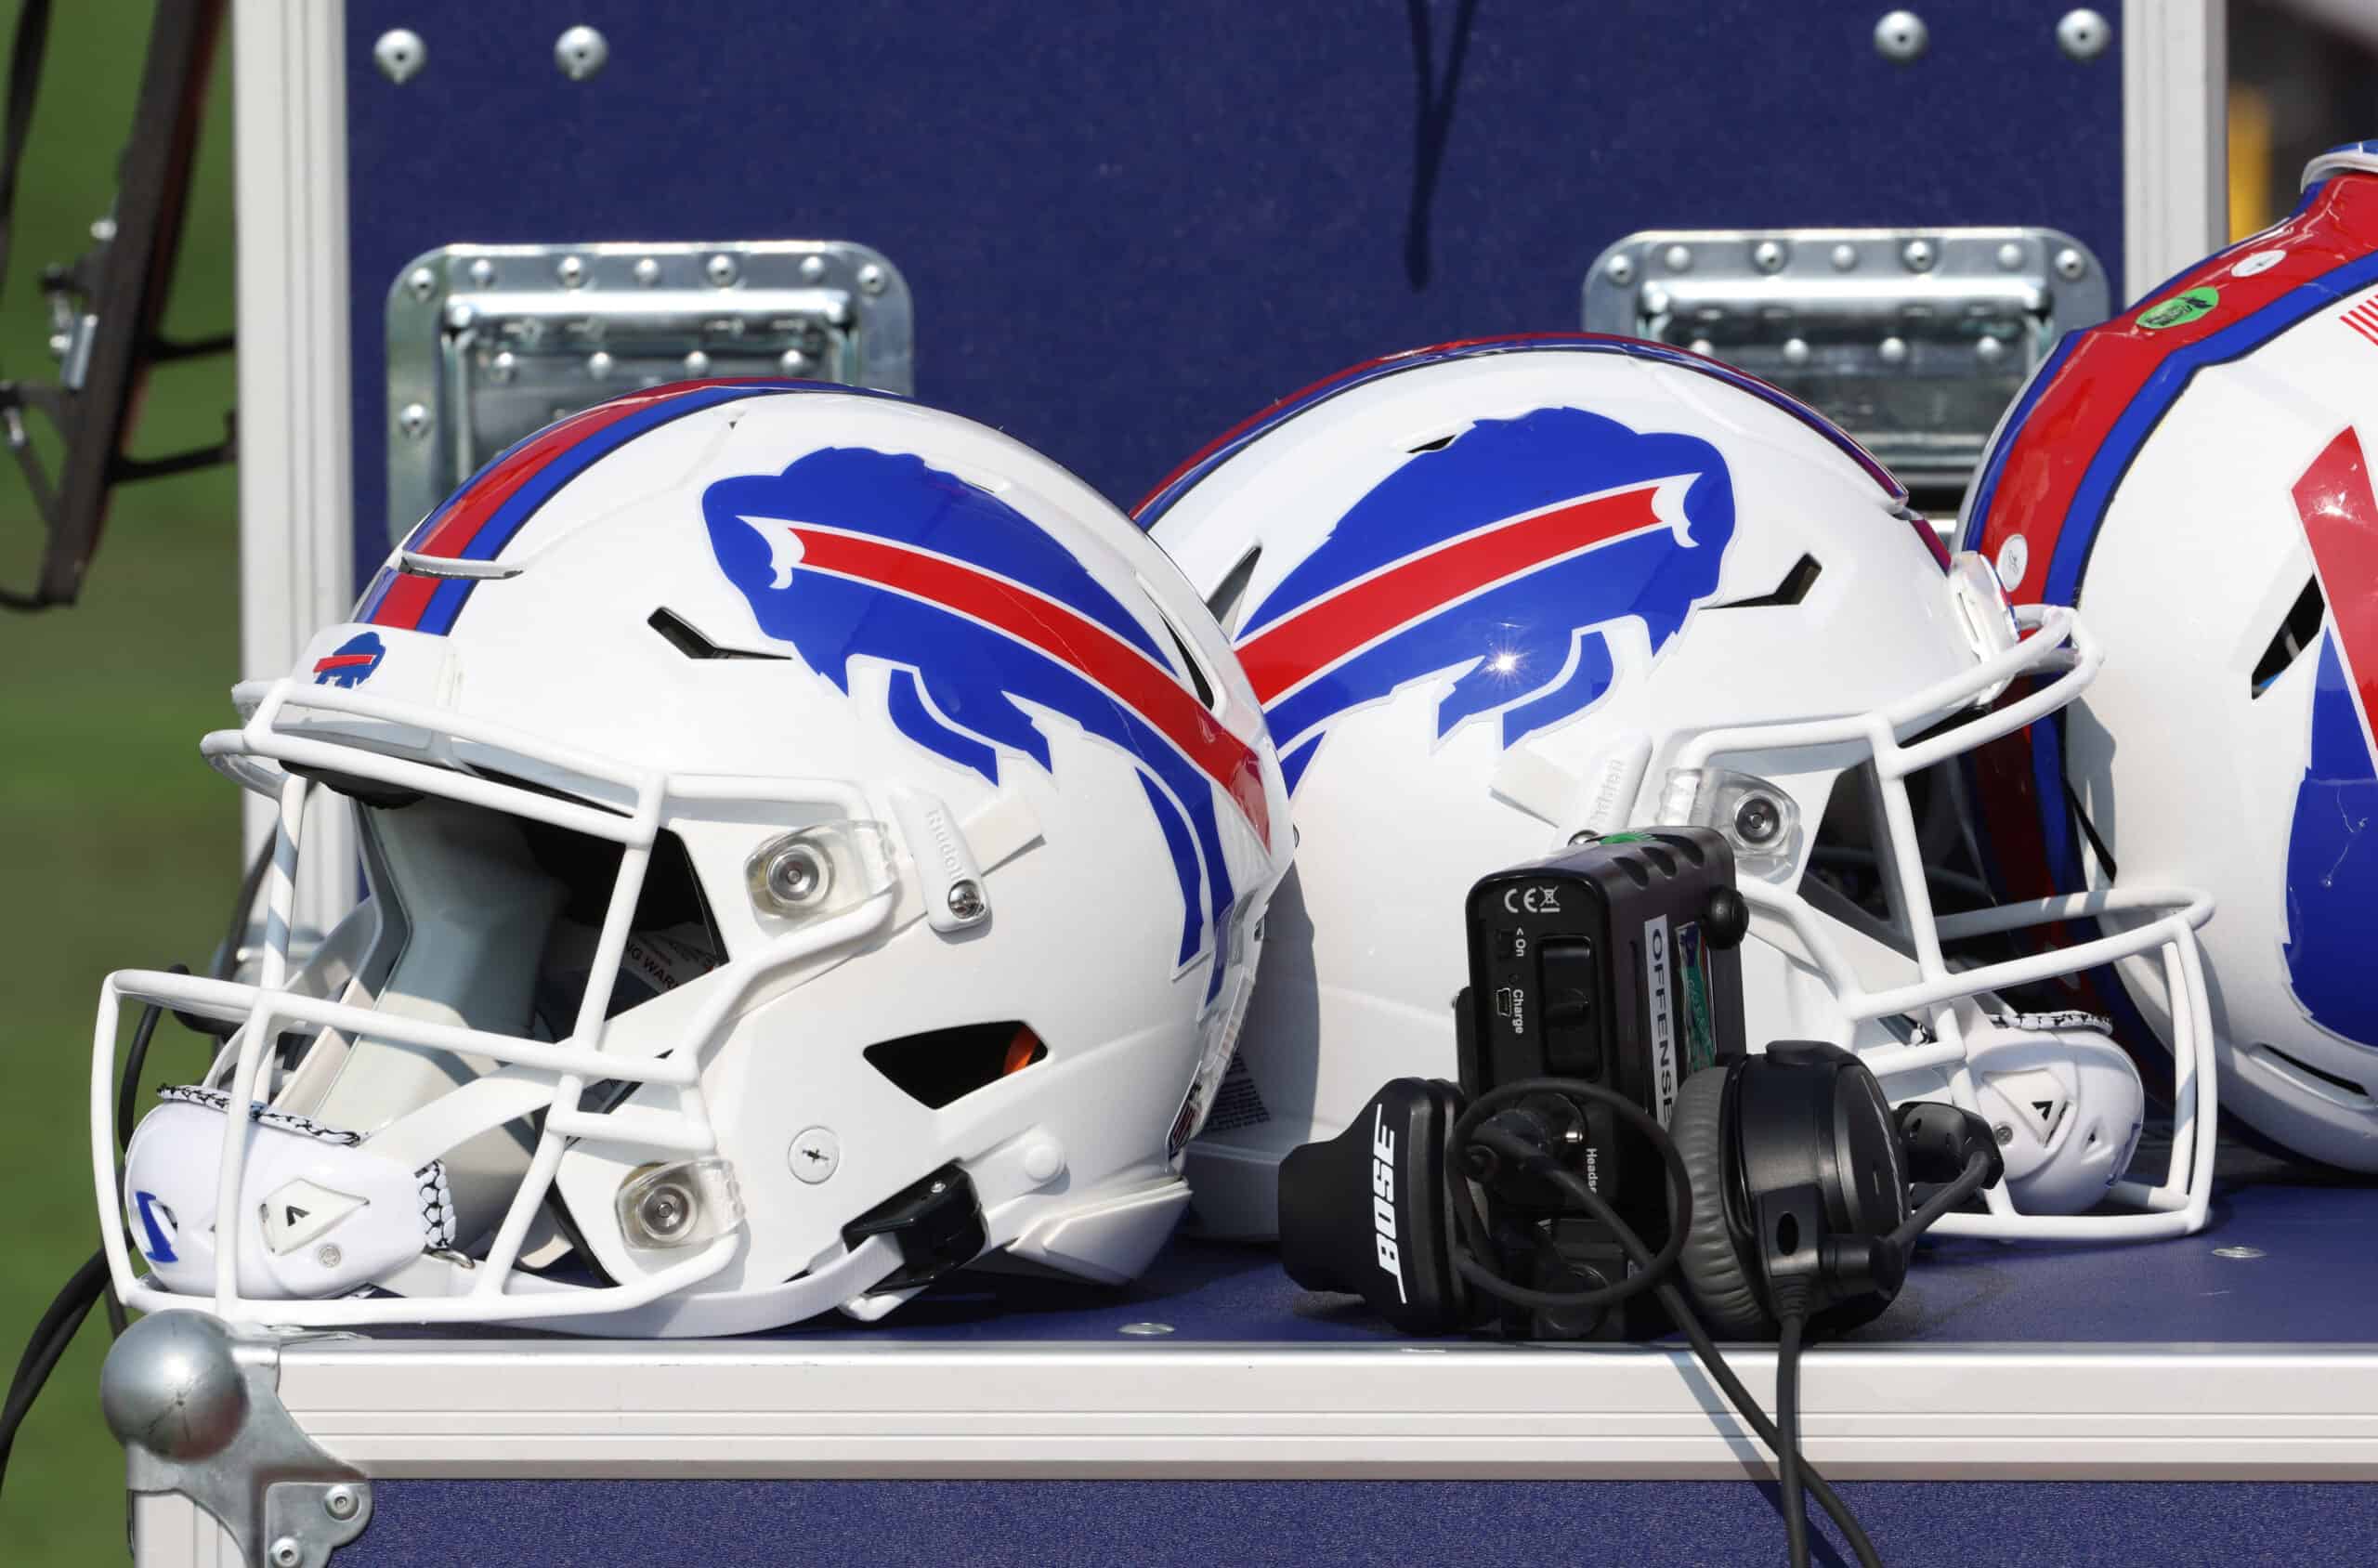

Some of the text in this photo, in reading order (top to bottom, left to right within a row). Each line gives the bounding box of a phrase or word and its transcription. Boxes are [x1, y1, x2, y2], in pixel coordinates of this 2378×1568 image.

[1515, 937, 1526, 958] On
[1512, 988, 1524, 1034] Charge
[1653, 929, 1673, 1123] OFFENSE
[1586, 1148, 1598, 1194] Heads
[1373, 1104, 1408, 1305] BOSE
